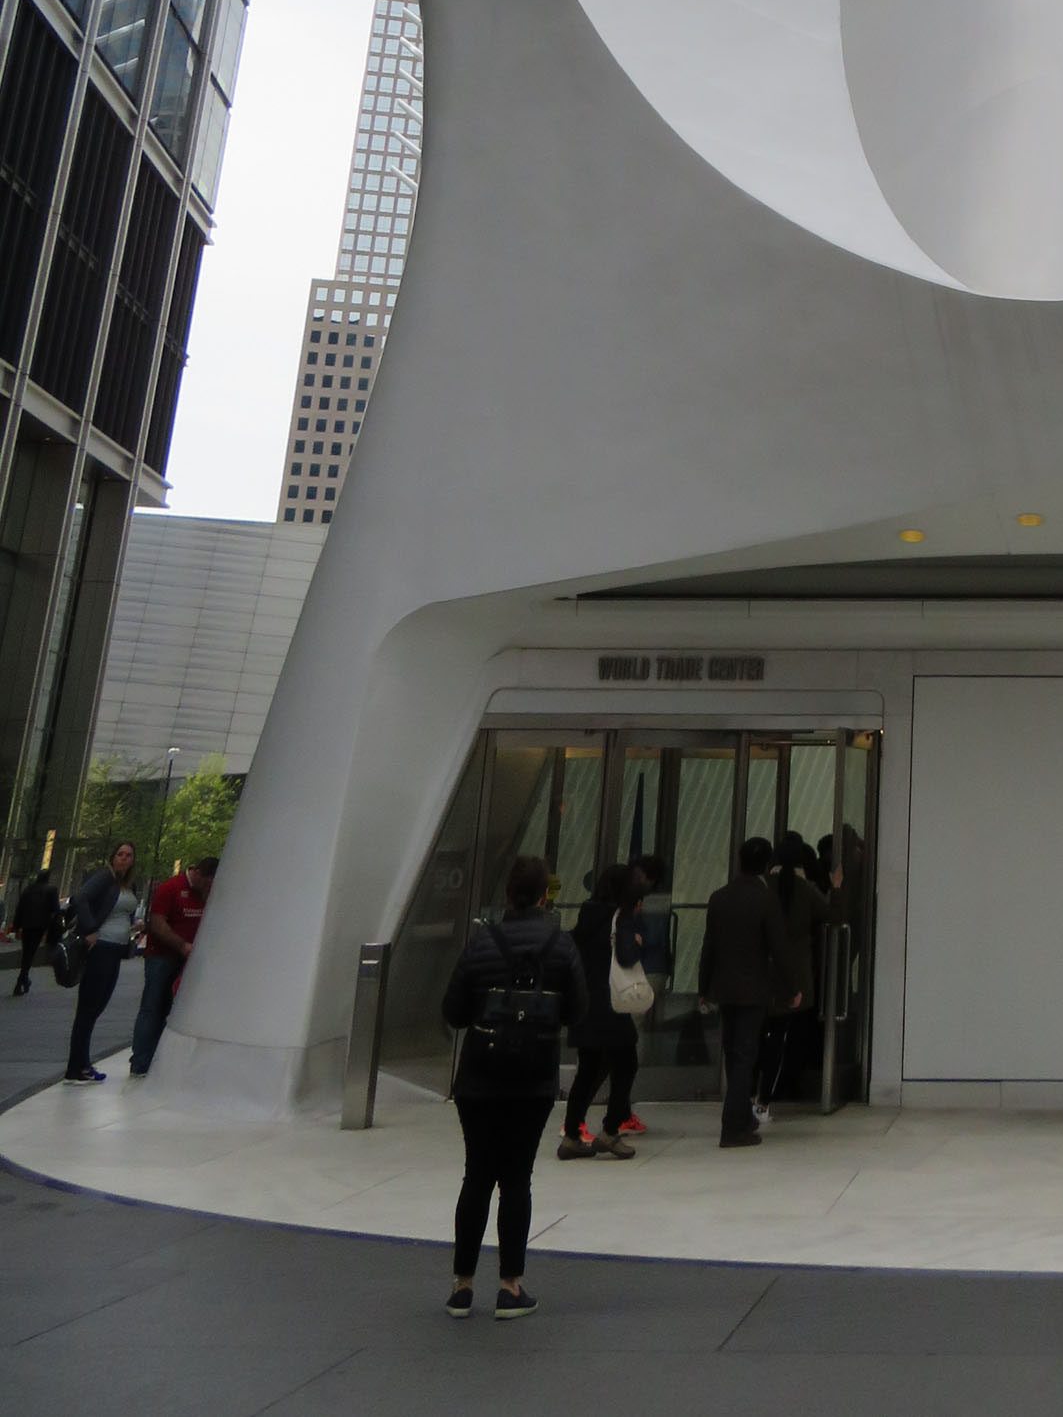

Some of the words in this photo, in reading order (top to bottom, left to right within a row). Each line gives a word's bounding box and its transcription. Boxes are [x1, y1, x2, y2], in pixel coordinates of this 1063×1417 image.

[598, 656, 649, 680] WORLD
[656, 656, 704, 680] TRADE
[708, 656, 764, 680] CENTER
